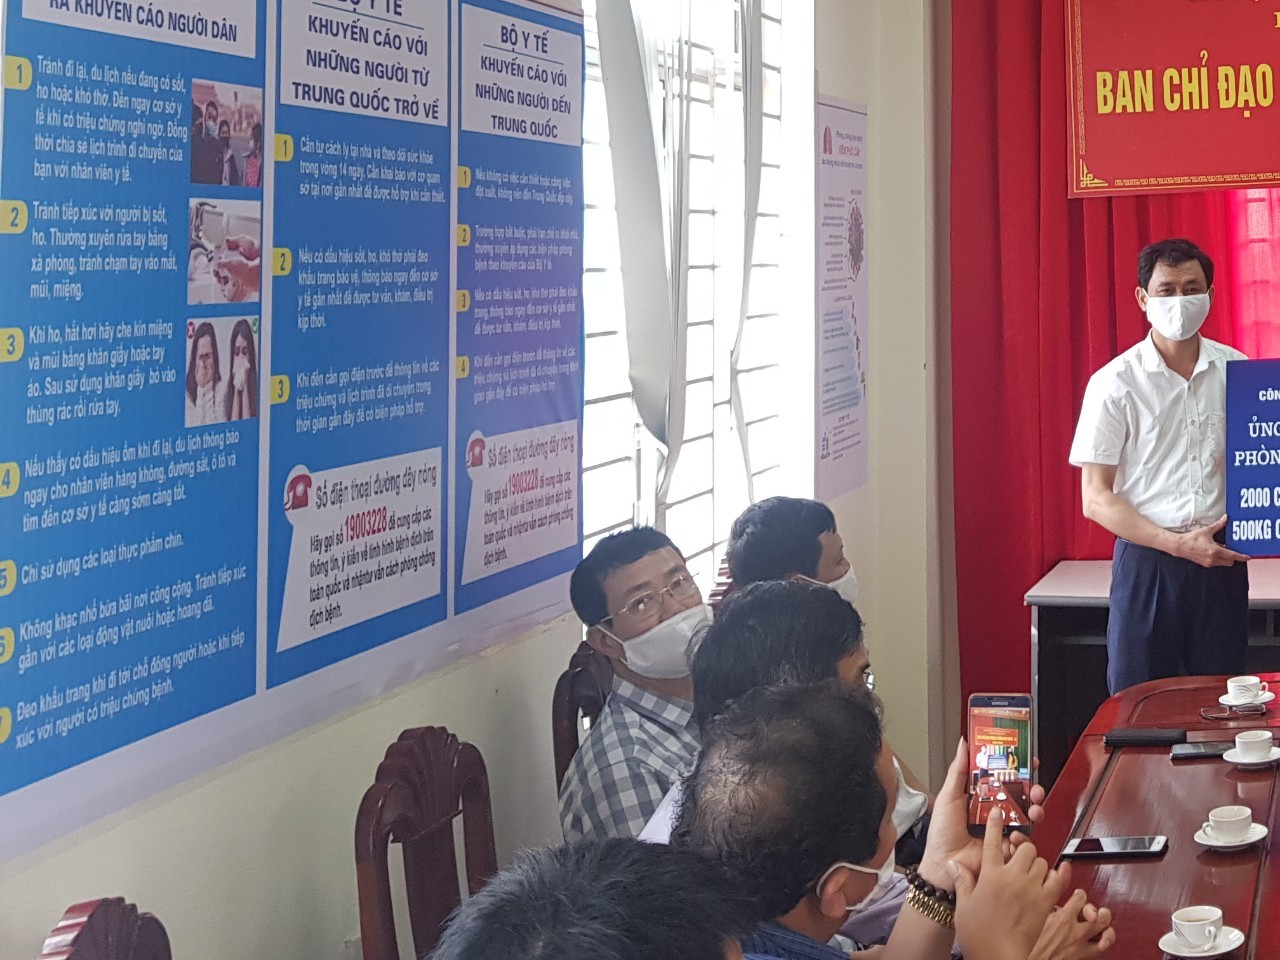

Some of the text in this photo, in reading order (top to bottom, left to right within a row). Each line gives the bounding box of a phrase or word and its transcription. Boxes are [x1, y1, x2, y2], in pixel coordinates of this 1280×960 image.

[136, 3, 164, 28] CÁO
[168, 11, 208, 37] NGƯỜI
[212, 18, 237, 42] DÂN
[308, 15, 427, 56] KHUYẾN CÁO VỚI
[500, 24, 549, 53] BỘ Y TẾ
[16, 64, 22, 84] 1
[306, 49, 429, 87] NHỮNG NGƯỜI TỪ
[481, 55, 567, 87] KHUYẾN CÁO VỚI
[1096, 70, 1154, 114] BAN
[1163, 50, 1209, 111] CHỈ
[1218, 63, 1273, 117] ĐẠO
[292, 81, 440, 119] TRUNG QUỐC TRỞ VỀ
[475, 82, 571, 114] NHỮNG NGƯỜI ĐẾN
[491, 115, 557, 139] TRUNG QUỐC
[284, 140, 287, 157] 1
[463, 171, 467, 185] 1
[10, 207, 19, 227] 2
[463, 228, 466, 242] 2
[280, 253, 285, 271] 2
[462, 293, 465, 308] 3
[7, 335, 15, 355] 3
[461, 359, 465, 373] 4
[278, 380, 283, 398] 3
[2, 469, 10, 489] 4
[1240, 488, 1271, 507] 2000
[345, 506, 387, 542] 19003228
[1232, 521, 1272, 540] 500KG
